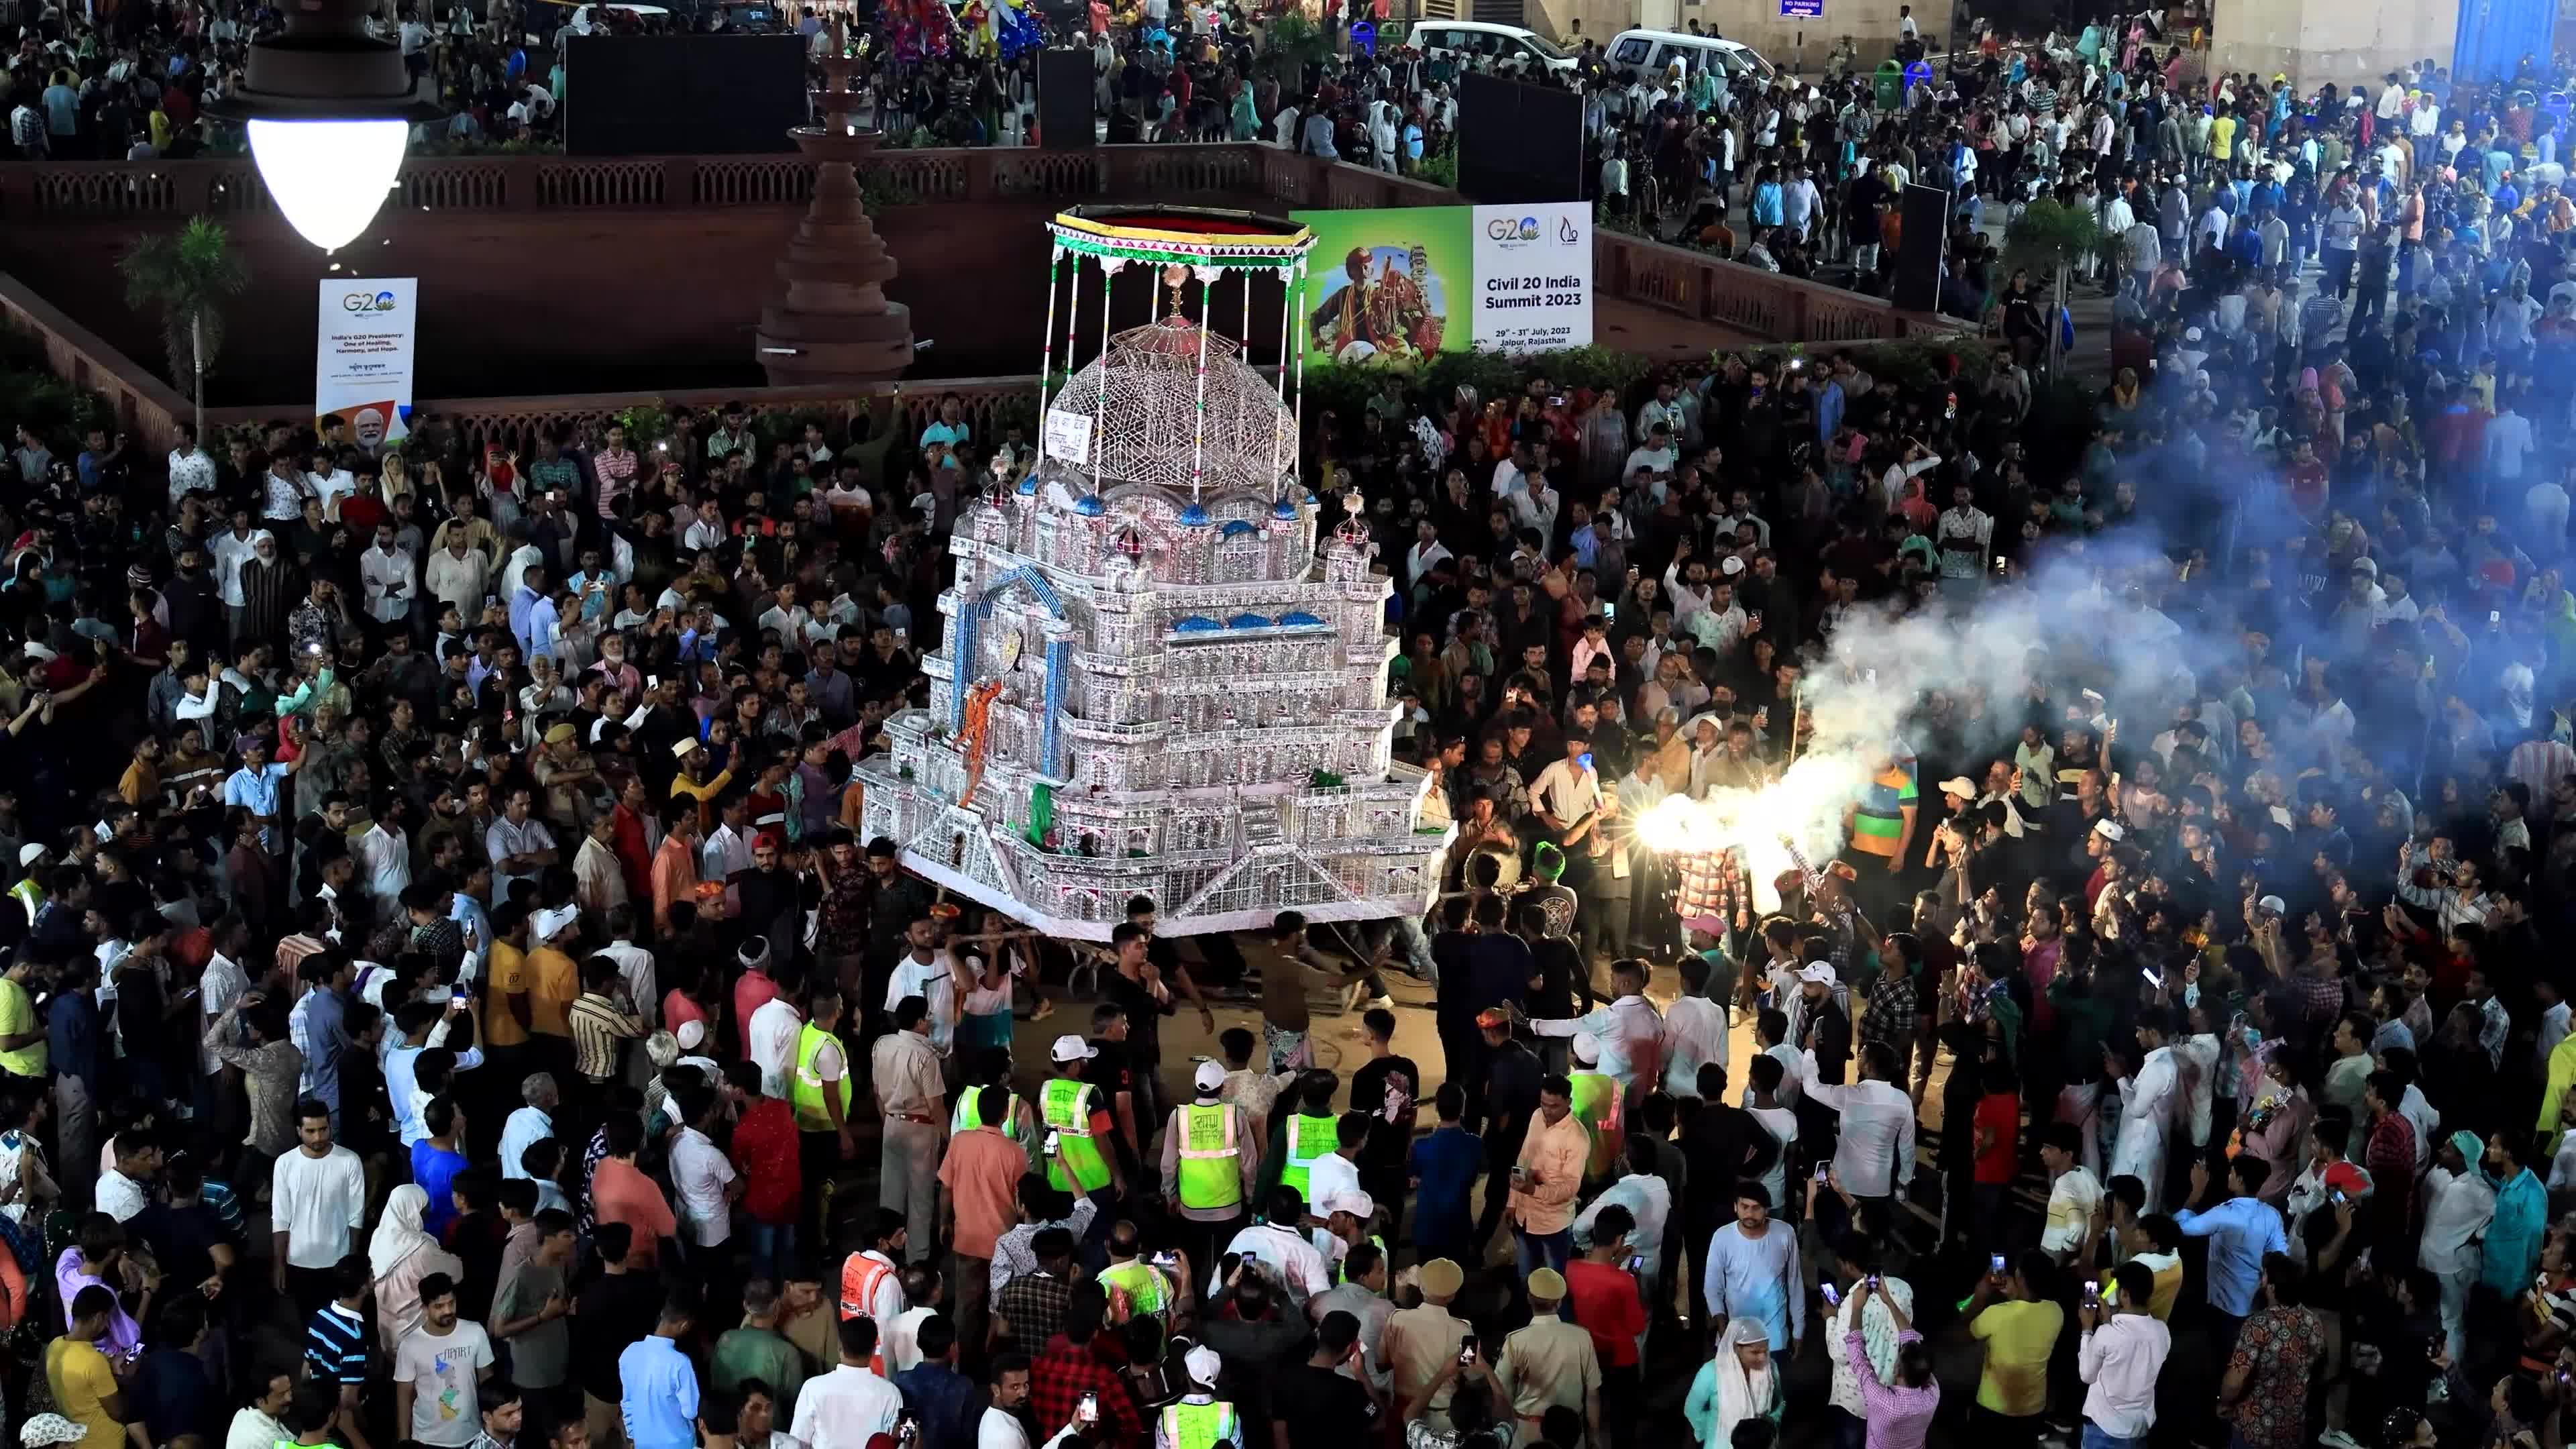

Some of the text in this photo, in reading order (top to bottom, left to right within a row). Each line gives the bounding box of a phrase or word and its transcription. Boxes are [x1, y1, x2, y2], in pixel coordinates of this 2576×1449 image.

[1488, 217, 1540, 241] G20
[1487, 276, 1580, 290] Civil 20 India
[343, 292, 396, 311] G20
[1486, 293, 1581, 309] Summit 2023
[1531, 327, 1549, 336] July,
[1551, 327, 1570, 335] 2023
[1500, 337, 1566, 347] Jaipur, Rajasthan
